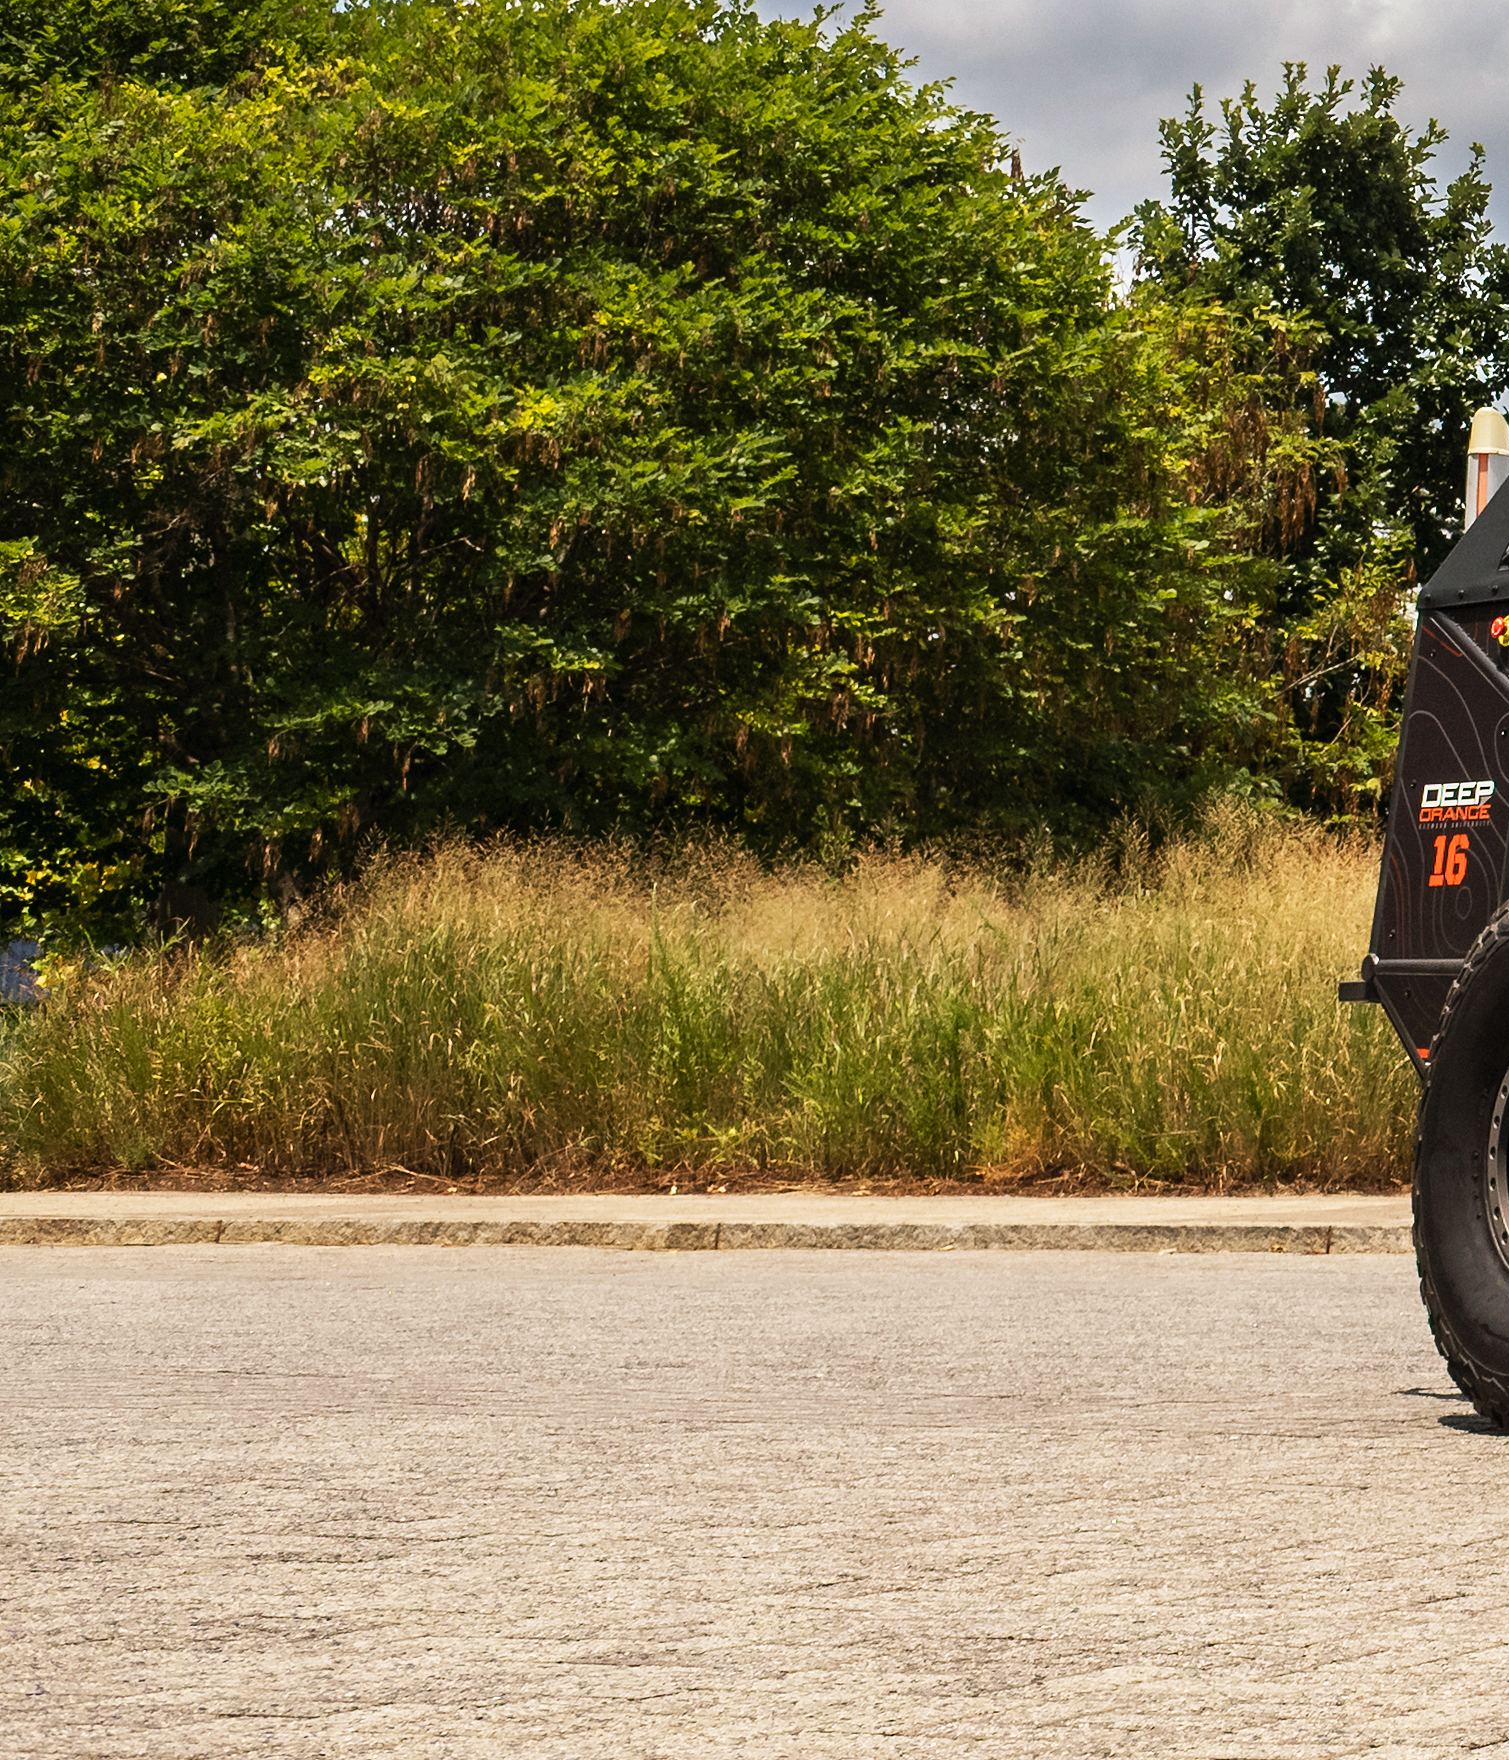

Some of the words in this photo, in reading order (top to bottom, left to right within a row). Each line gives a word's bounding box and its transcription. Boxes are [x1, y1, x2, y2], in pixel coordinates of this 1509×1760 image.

[1421, 781, 1495, 808] DEEP
[1419, 804, 1492, 822] ORANGE
[1428, 834, 1470, 887] 16
